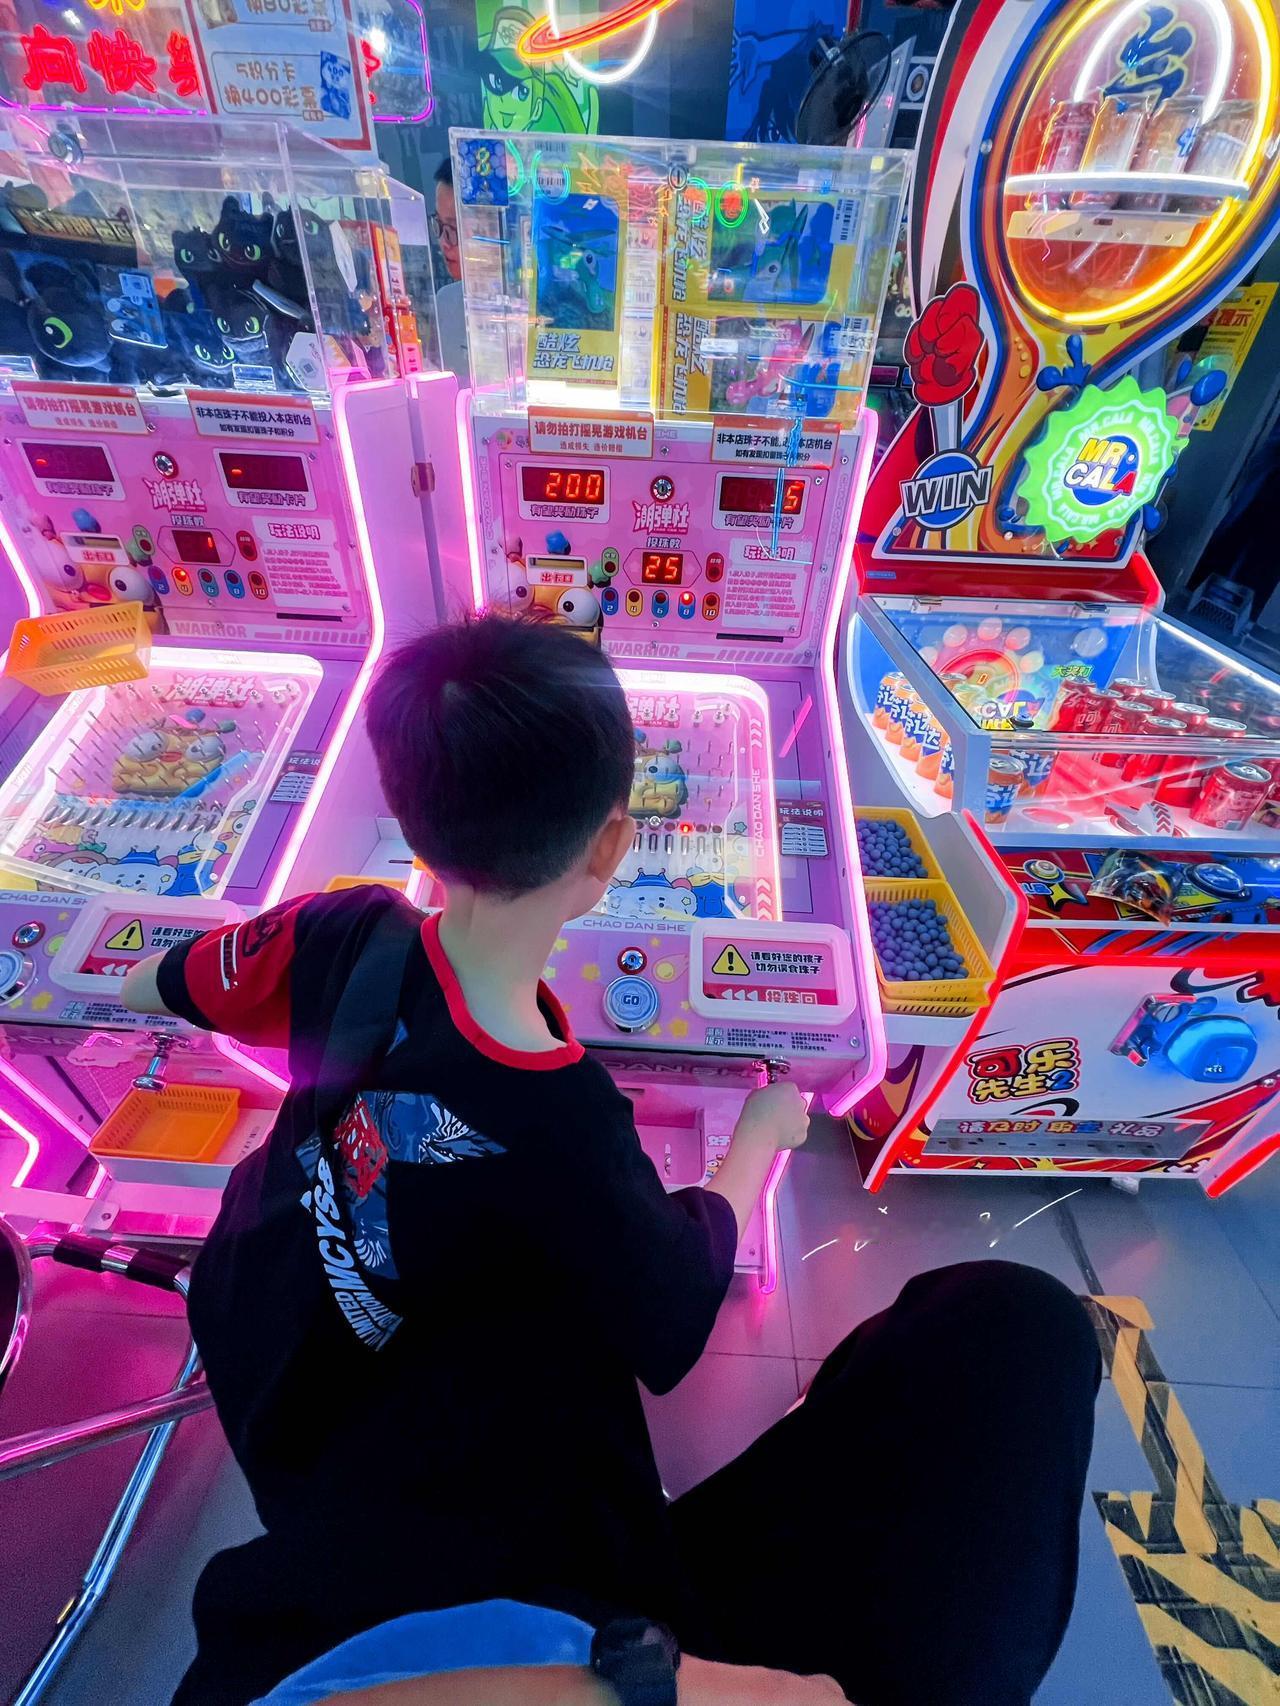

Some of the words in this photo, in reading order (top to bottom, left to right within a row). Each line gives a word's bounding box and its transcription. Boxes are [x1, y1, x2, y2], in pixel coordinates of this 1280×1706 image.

[536, 333, 581, 353] 酷炫
[532, 351, 615, 372] 恐龙飞机枪
[196, 406, 312, 426] 非本店珠子不能投入本店机台
[535, 421, 648, 440] 请勿拍打摇晃游戏机台
[716, 433, 833, 450] 非本店珠子不能本店机台
[735, 449, 811, 461] 如有发现扣留珠子积分
[546, 472, 601, 499] 200
[1063, 462, 1138, 497] CALA
[783, 483, 805, 511] 5
[900, 466, 994, 517] WIN
[530, 504, 599, 519] 有望奖励珠子
[645, 556, 679, 578] 25
[541, 572, 574, 583] 出卡口
[174, 622, 247, 638] WARRIOR
[608, 642, 680, 657] WARRIOR
[41, 895, 70, 904] DAN
[71, 898, 89, 906] SH
[582, 919, 623, 930] CHAO
[623, 922, 655, 932] DAN
[656, 924, 686, 932] SHE
[751, 951, 824, 964] 请看好您的孩子
[756, 964, 821, 975] 切勿误食珠子
[623, 994, 640, 1006] GO
[969, 1041, 1076, 1077] 可乐
[974, 1070, 1076, 1101] 先生2
[1109, 1122, 1166, 1137] 礼品
